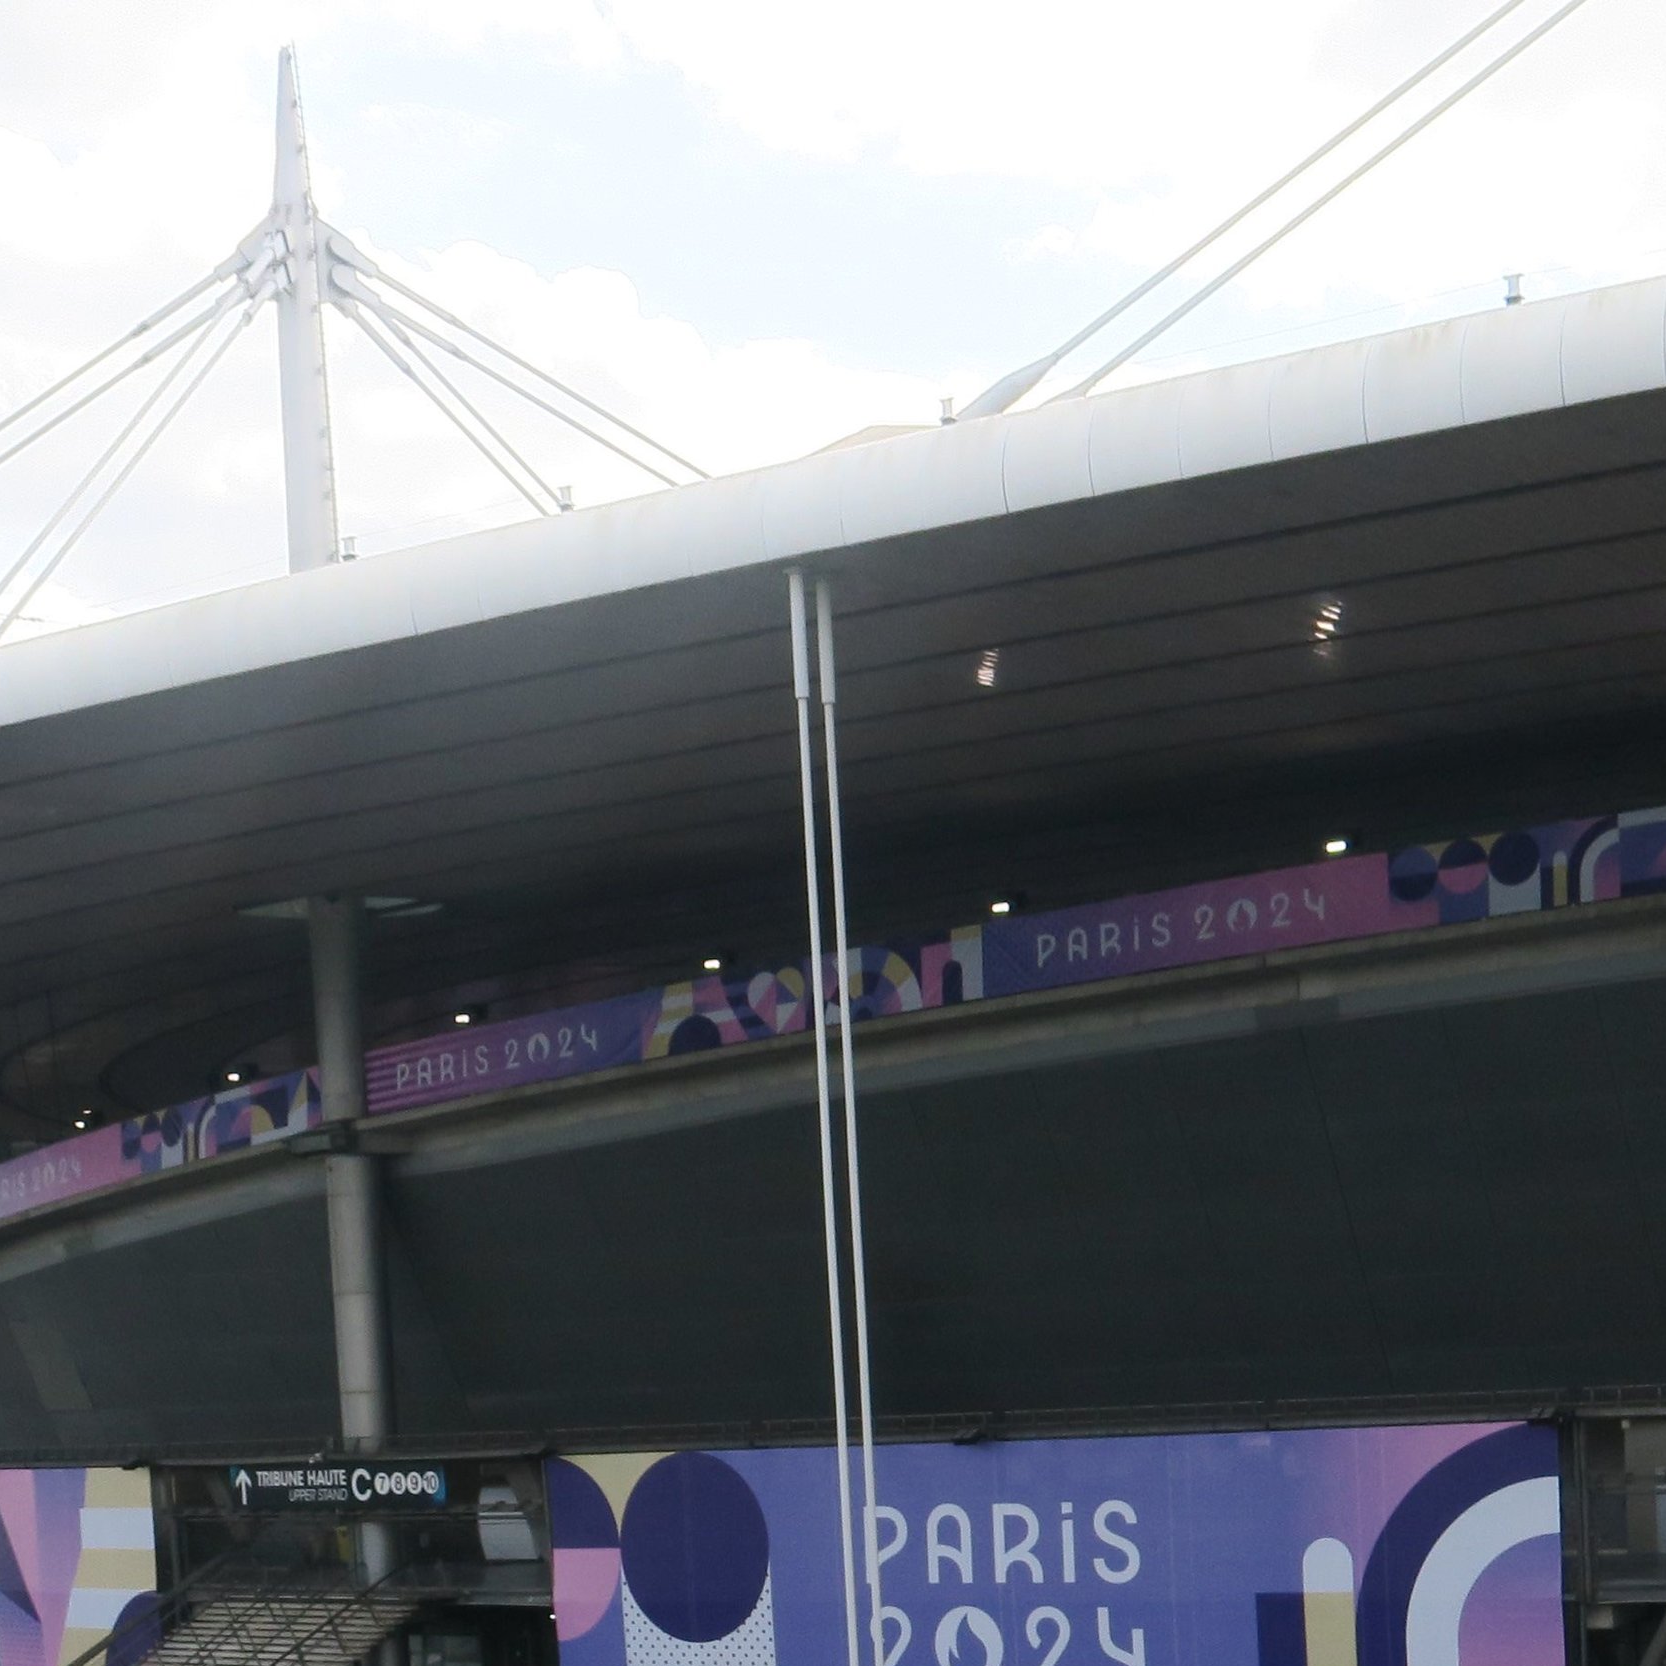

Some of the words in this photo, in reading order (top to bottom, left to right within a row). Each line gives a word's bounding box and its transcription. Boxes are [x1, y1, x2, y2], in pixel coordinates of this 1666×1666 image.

[1194, 888, 1326, 941] 2024
[505, 1023, 598, 1071] 2024
[256, 1470, 304, 1488] TRIBUNE
[307, 1468, 347, 1487] HAUTE
[351, 1467, 373, 1502] C
